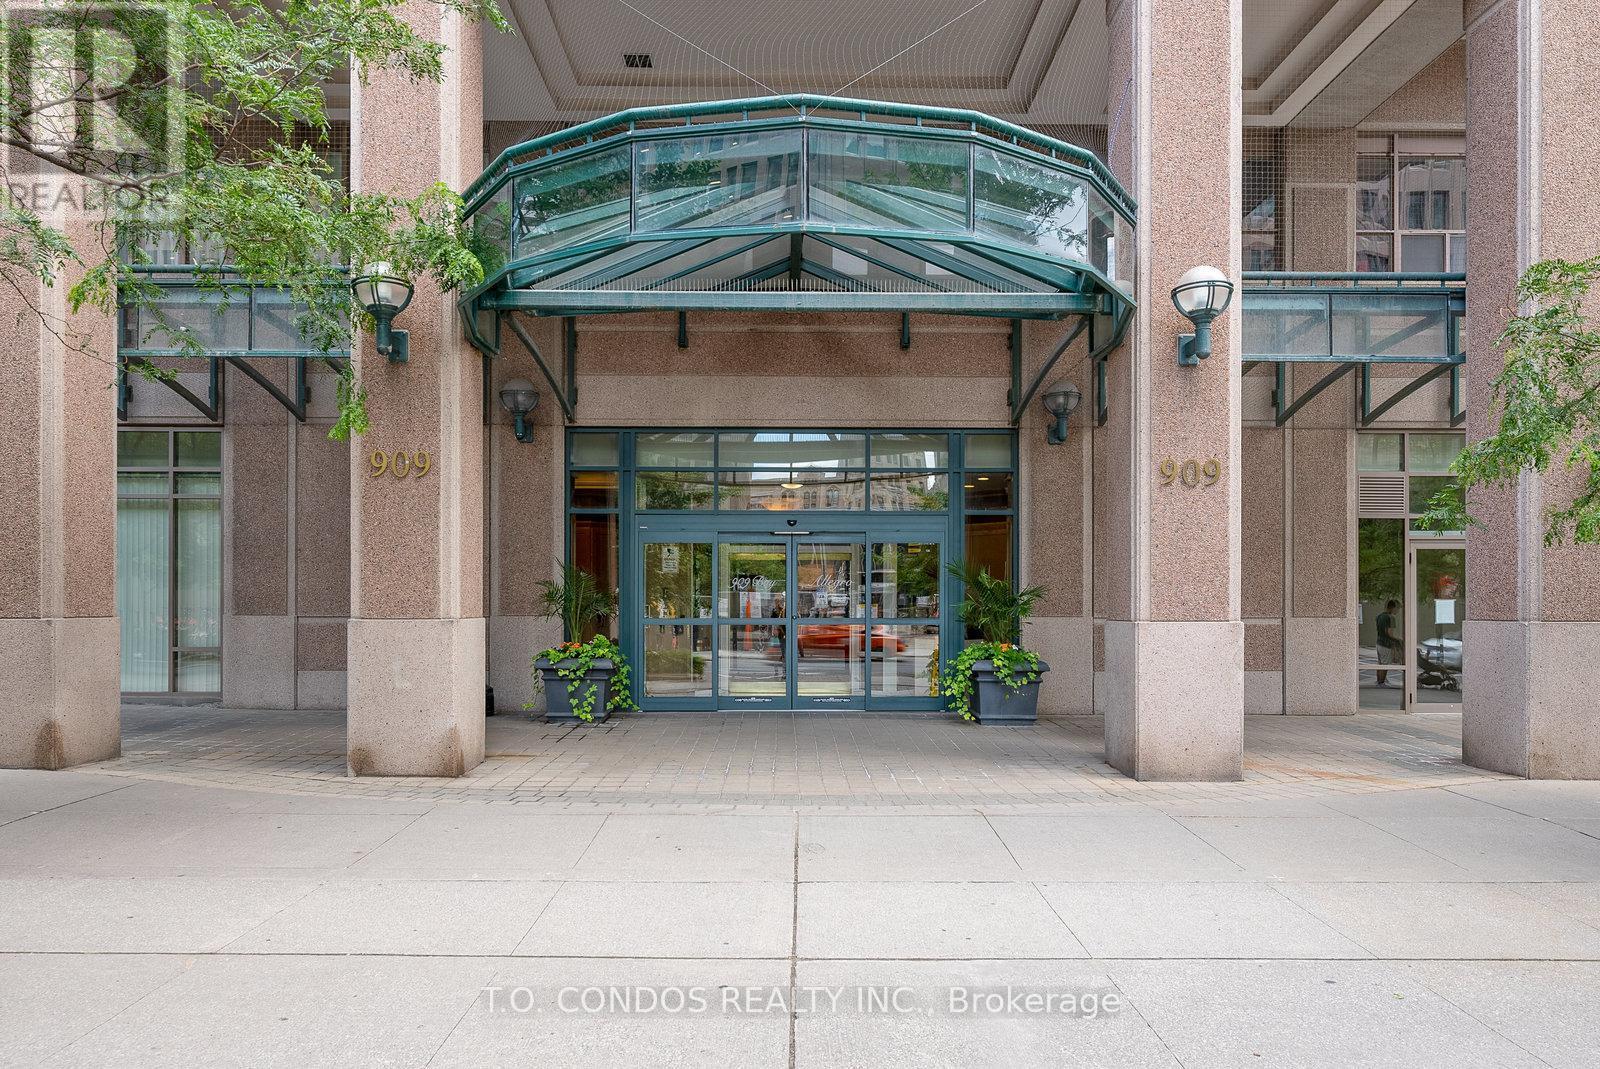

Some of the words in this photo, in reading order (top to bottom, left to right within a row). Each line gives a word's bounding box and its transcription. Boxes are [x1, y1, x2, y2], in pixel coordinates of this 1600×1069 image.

[370, 450, 431, 478] 909
[1160, 457, 1221, 487] 909
[730, 576, 751, 591] 909
[808, 573, 853, 591] Allegro
